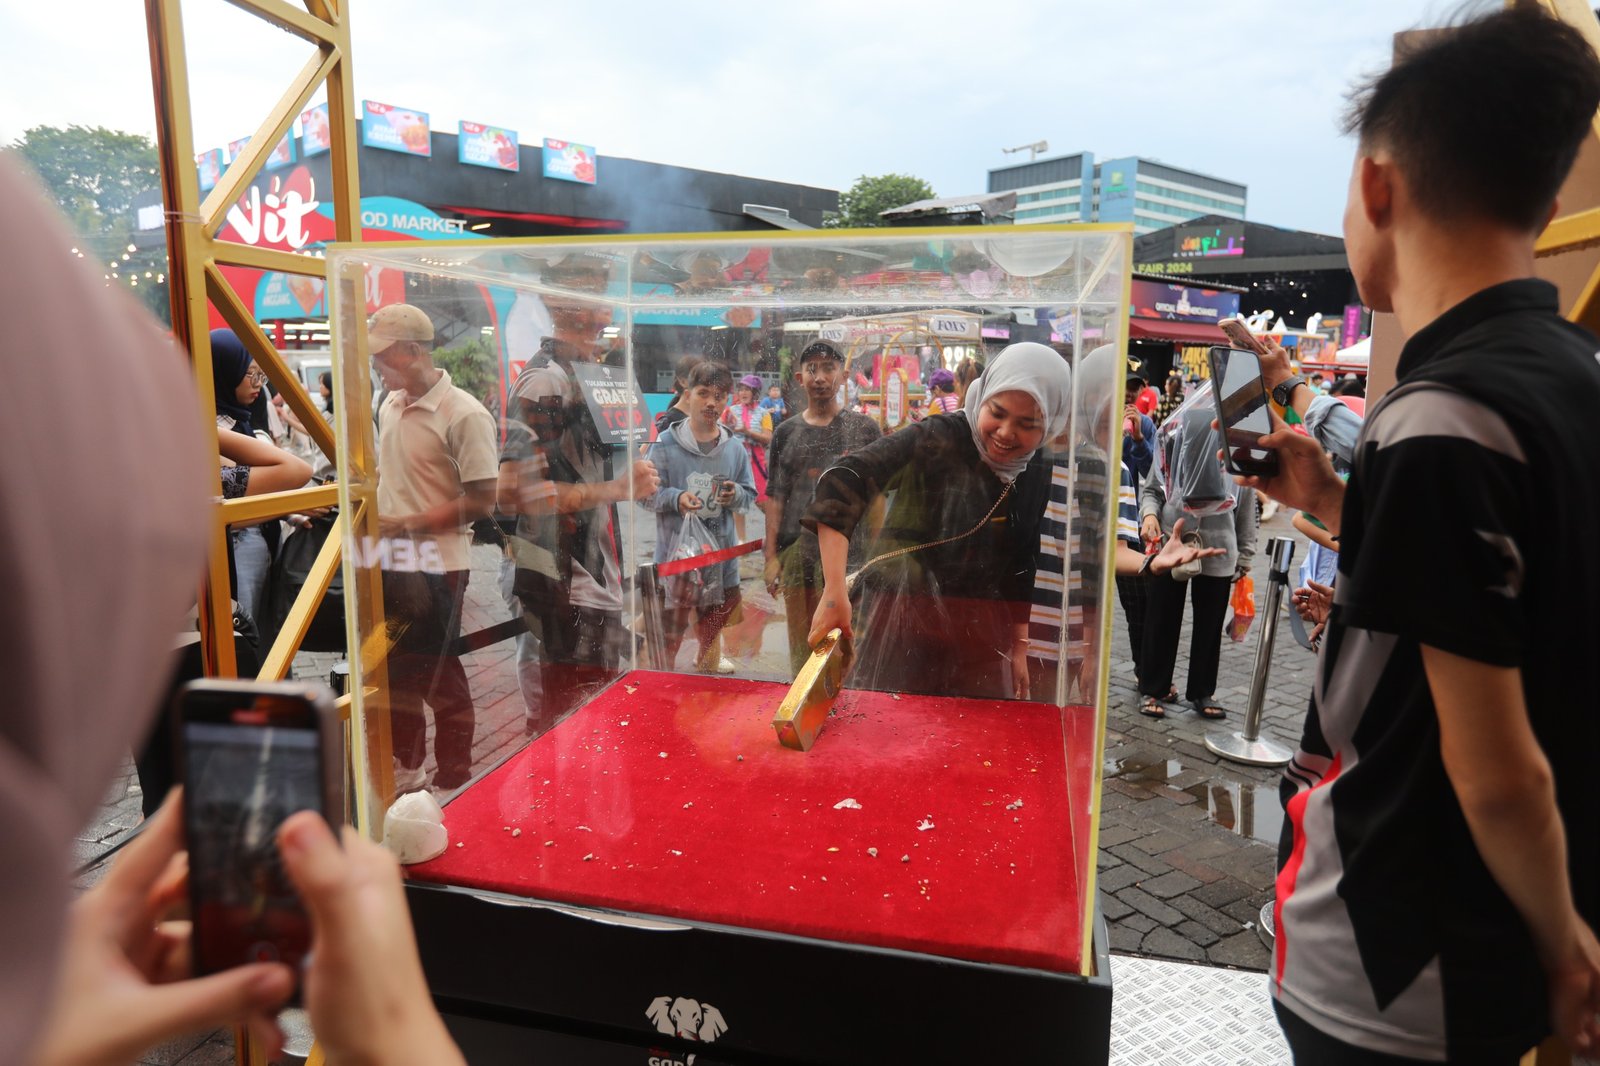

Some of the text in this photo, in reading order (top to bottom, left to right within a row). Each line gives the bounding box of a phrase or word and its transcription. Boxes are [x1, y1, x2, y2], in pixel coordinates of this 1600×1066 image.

[226, 185, 320, 249] Vit
[361, 211, 467, 234] OD MARKET
[1138, 263, 1164, 273] FAIR
[1167, 263, 1193, 273] 2024
[593, 389, 638, 404] GRATS
